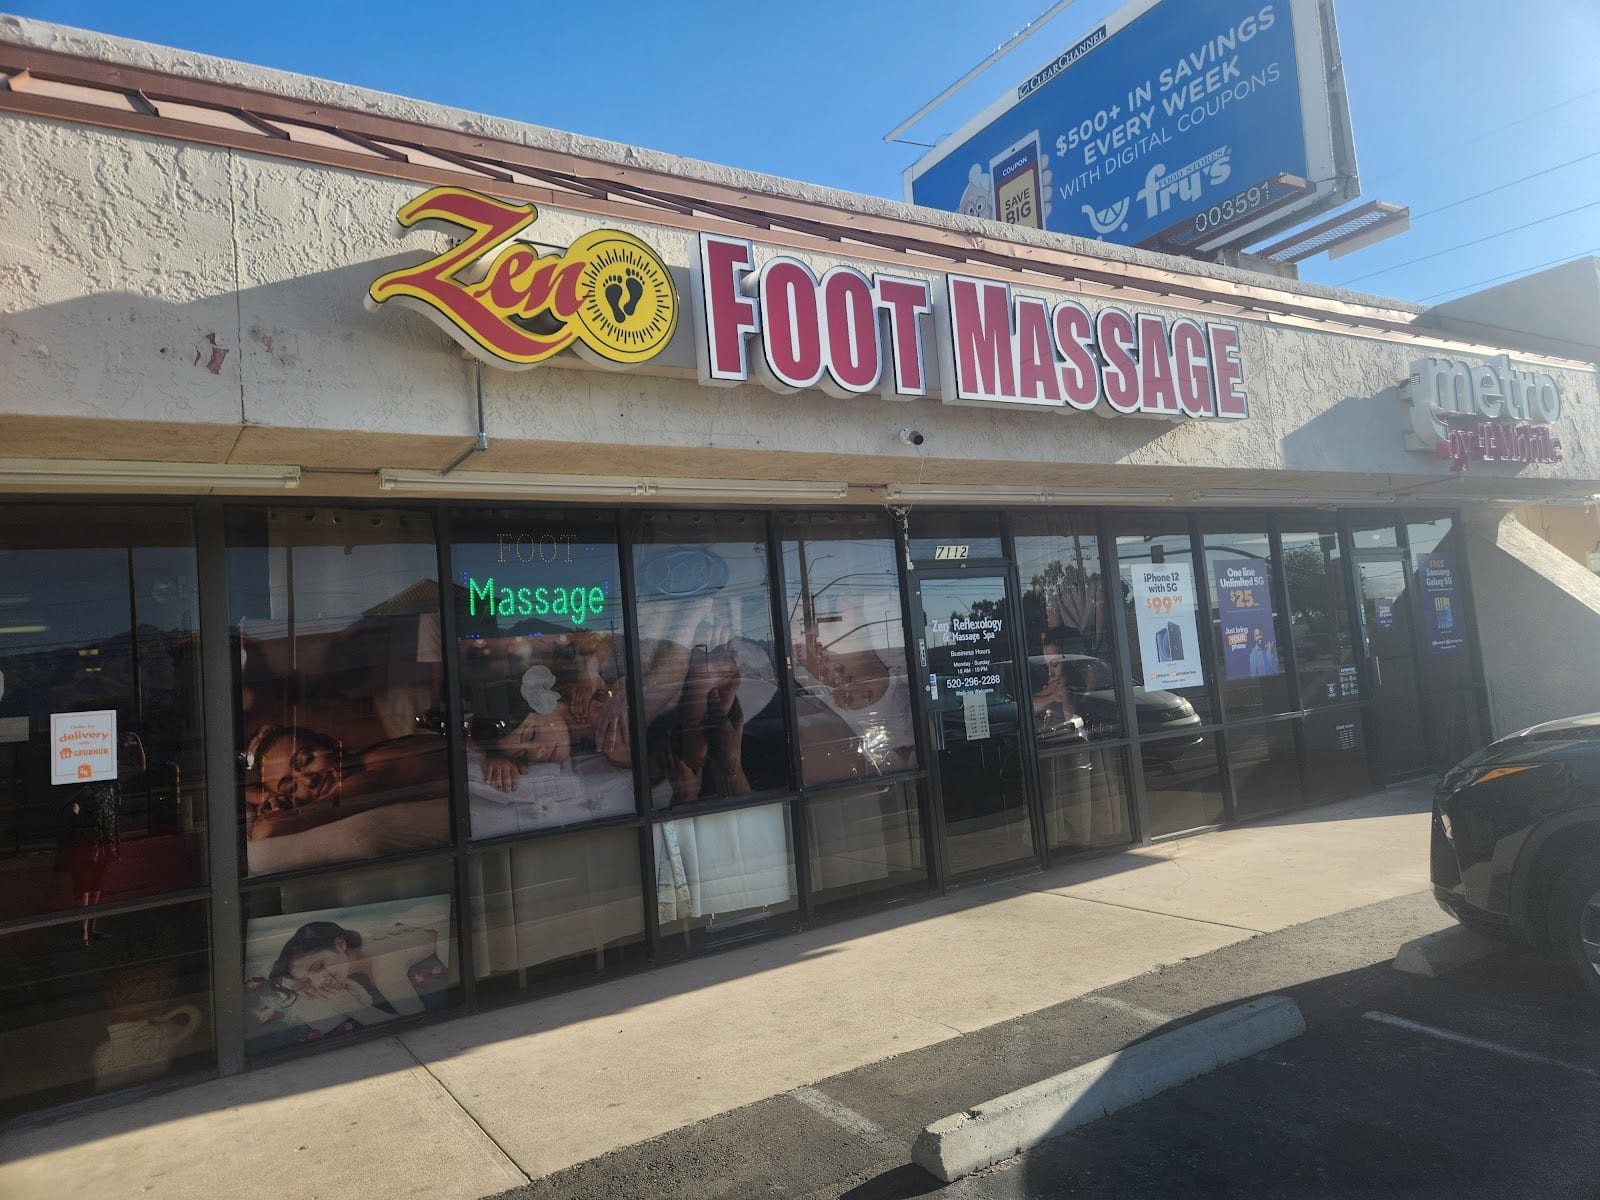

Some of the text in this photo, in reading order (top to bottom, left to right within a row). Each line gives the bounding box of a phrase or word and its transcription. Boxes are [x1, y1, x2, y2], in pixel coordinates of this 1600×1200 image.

[1056, 5, 1275, 157] $500+ IN SAVINGS
[1084, 56, 1241, 165] EVERY WEEK
[1059, 63, 1281, 200] WITH DIGITAL COUPONS
[1002, 156, 1027, 176] COUPON
[1159, 171, 1183, 187] FOOD
[1005, 188, 1030, 210] SAVE
[1196, 181, 1270, 231] 003591
[1006, 201, 1031, 224] BIG
[371, 187, 1247, 417] Zen FOOT MASSAGE
[1422, 354, 1561, 430] metro
[496, 533, 577, 563] FOOT
[936, 546, 968, 559] 7112
[1143, 572, 1179, 584] iPhone 12
[1227, 566, 1256, 577] One line
[1148, 582, 1178, 593] with 5G
[1220, 576, 1265, 588] Unlimited 5G
[469, 578, 605, 624] Massage
[1230, 589, 1254, 608] $25
[931, 617, 1002, 633] Zen Reflexology
[943, 630, 995, 643] & Massage Spa
[946, 675, 1001, 689] 520-296-2288
[59, 731, 109, 742] delivery
[74, 747, 108, 757] GRUBHUB
